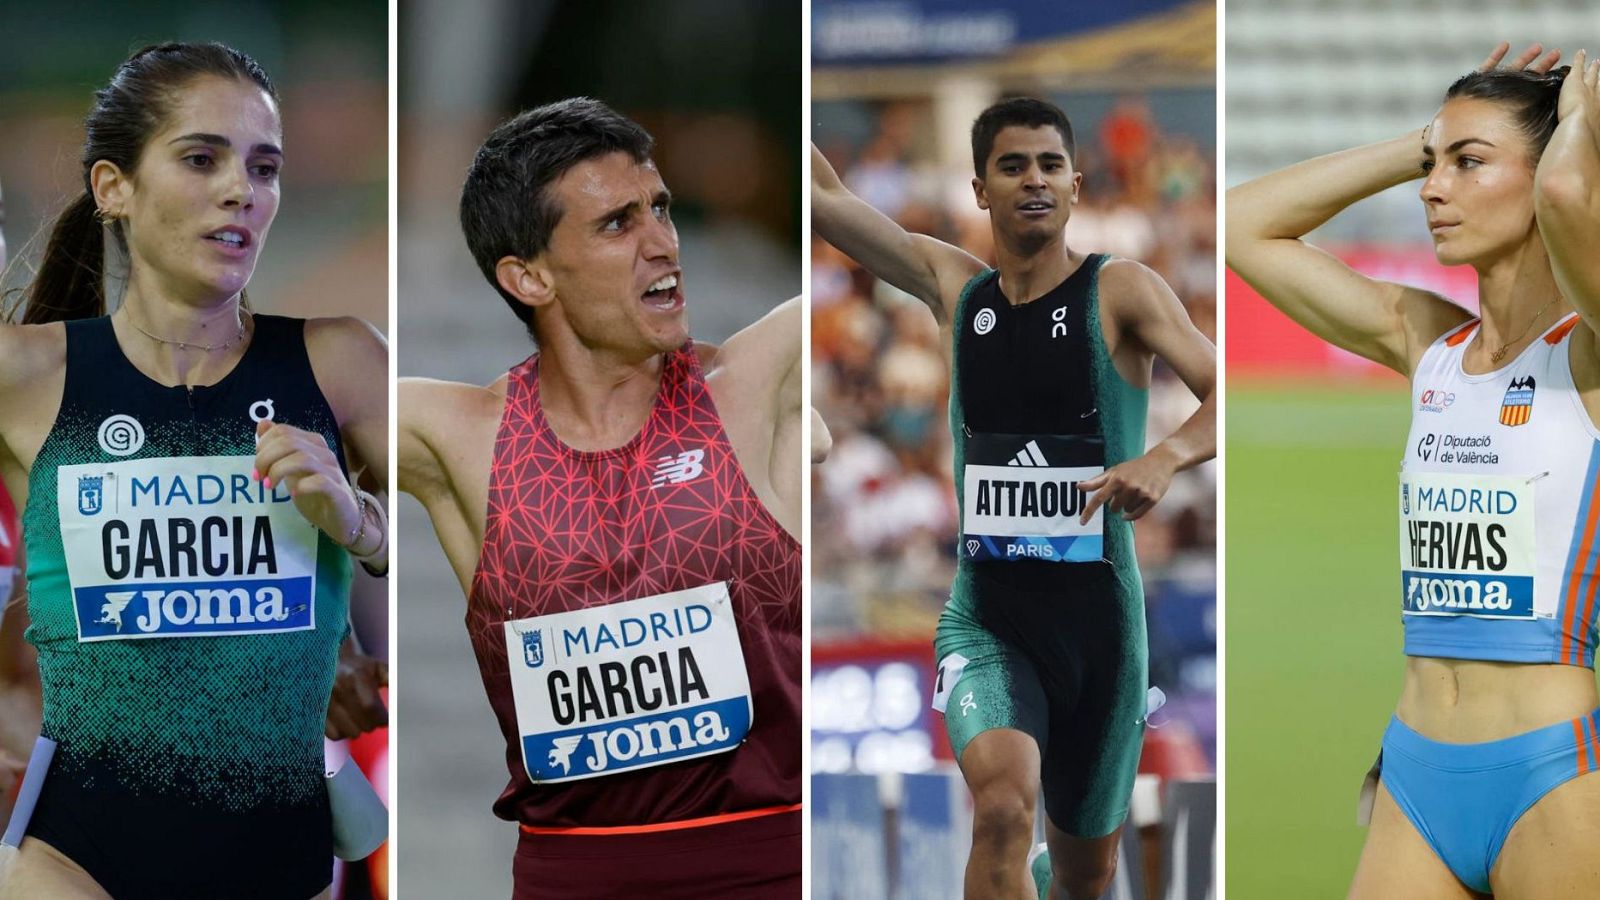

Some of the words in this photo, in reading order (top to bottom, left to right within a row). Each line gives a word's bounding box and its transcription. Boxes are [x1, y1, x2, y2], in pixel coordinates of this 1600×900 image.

[1440, 451, 1454, 463] de
[1456, 452, 1499, 464] València
[1443, 435, 1491, 449] Diputació
[1418, 487, 1517, 515] MADRID
[101, 516, 278, 580] GARCIA
[1006, 544, 1053, 557] PARIS
[1408, 520, 1507, 571] HERVAS
[563, 604, 712, 657] MADRID
[546, 646, 710, 726] GARCIA
